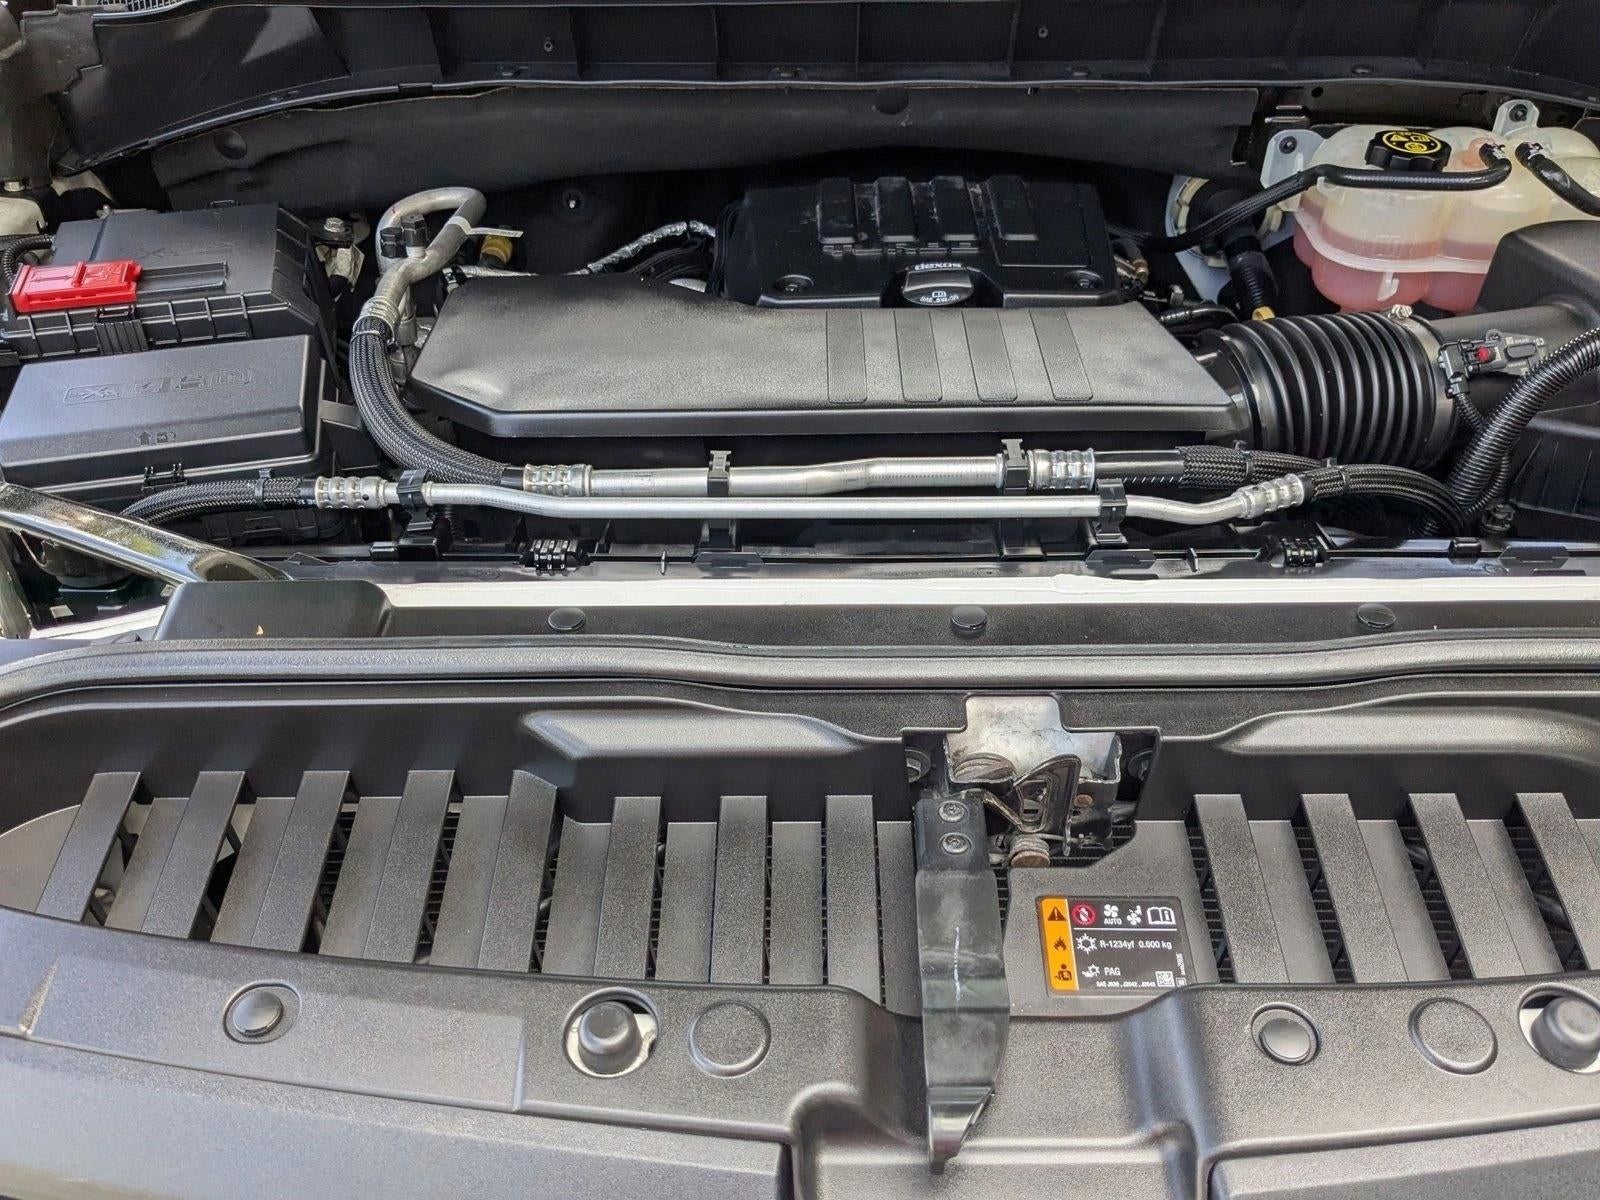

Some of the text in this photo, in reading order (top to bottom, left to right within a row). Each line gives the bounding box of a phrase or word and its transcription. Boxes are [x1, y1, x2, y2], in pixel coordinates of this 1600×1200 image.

[914, 262, 962, 270] dexos
[1104, 917, 1122, 925] AUTO
[1099, 940, 1173, 950] R-1234yf 0.600 kg
[1104, 967, 1121, 976] PAG
